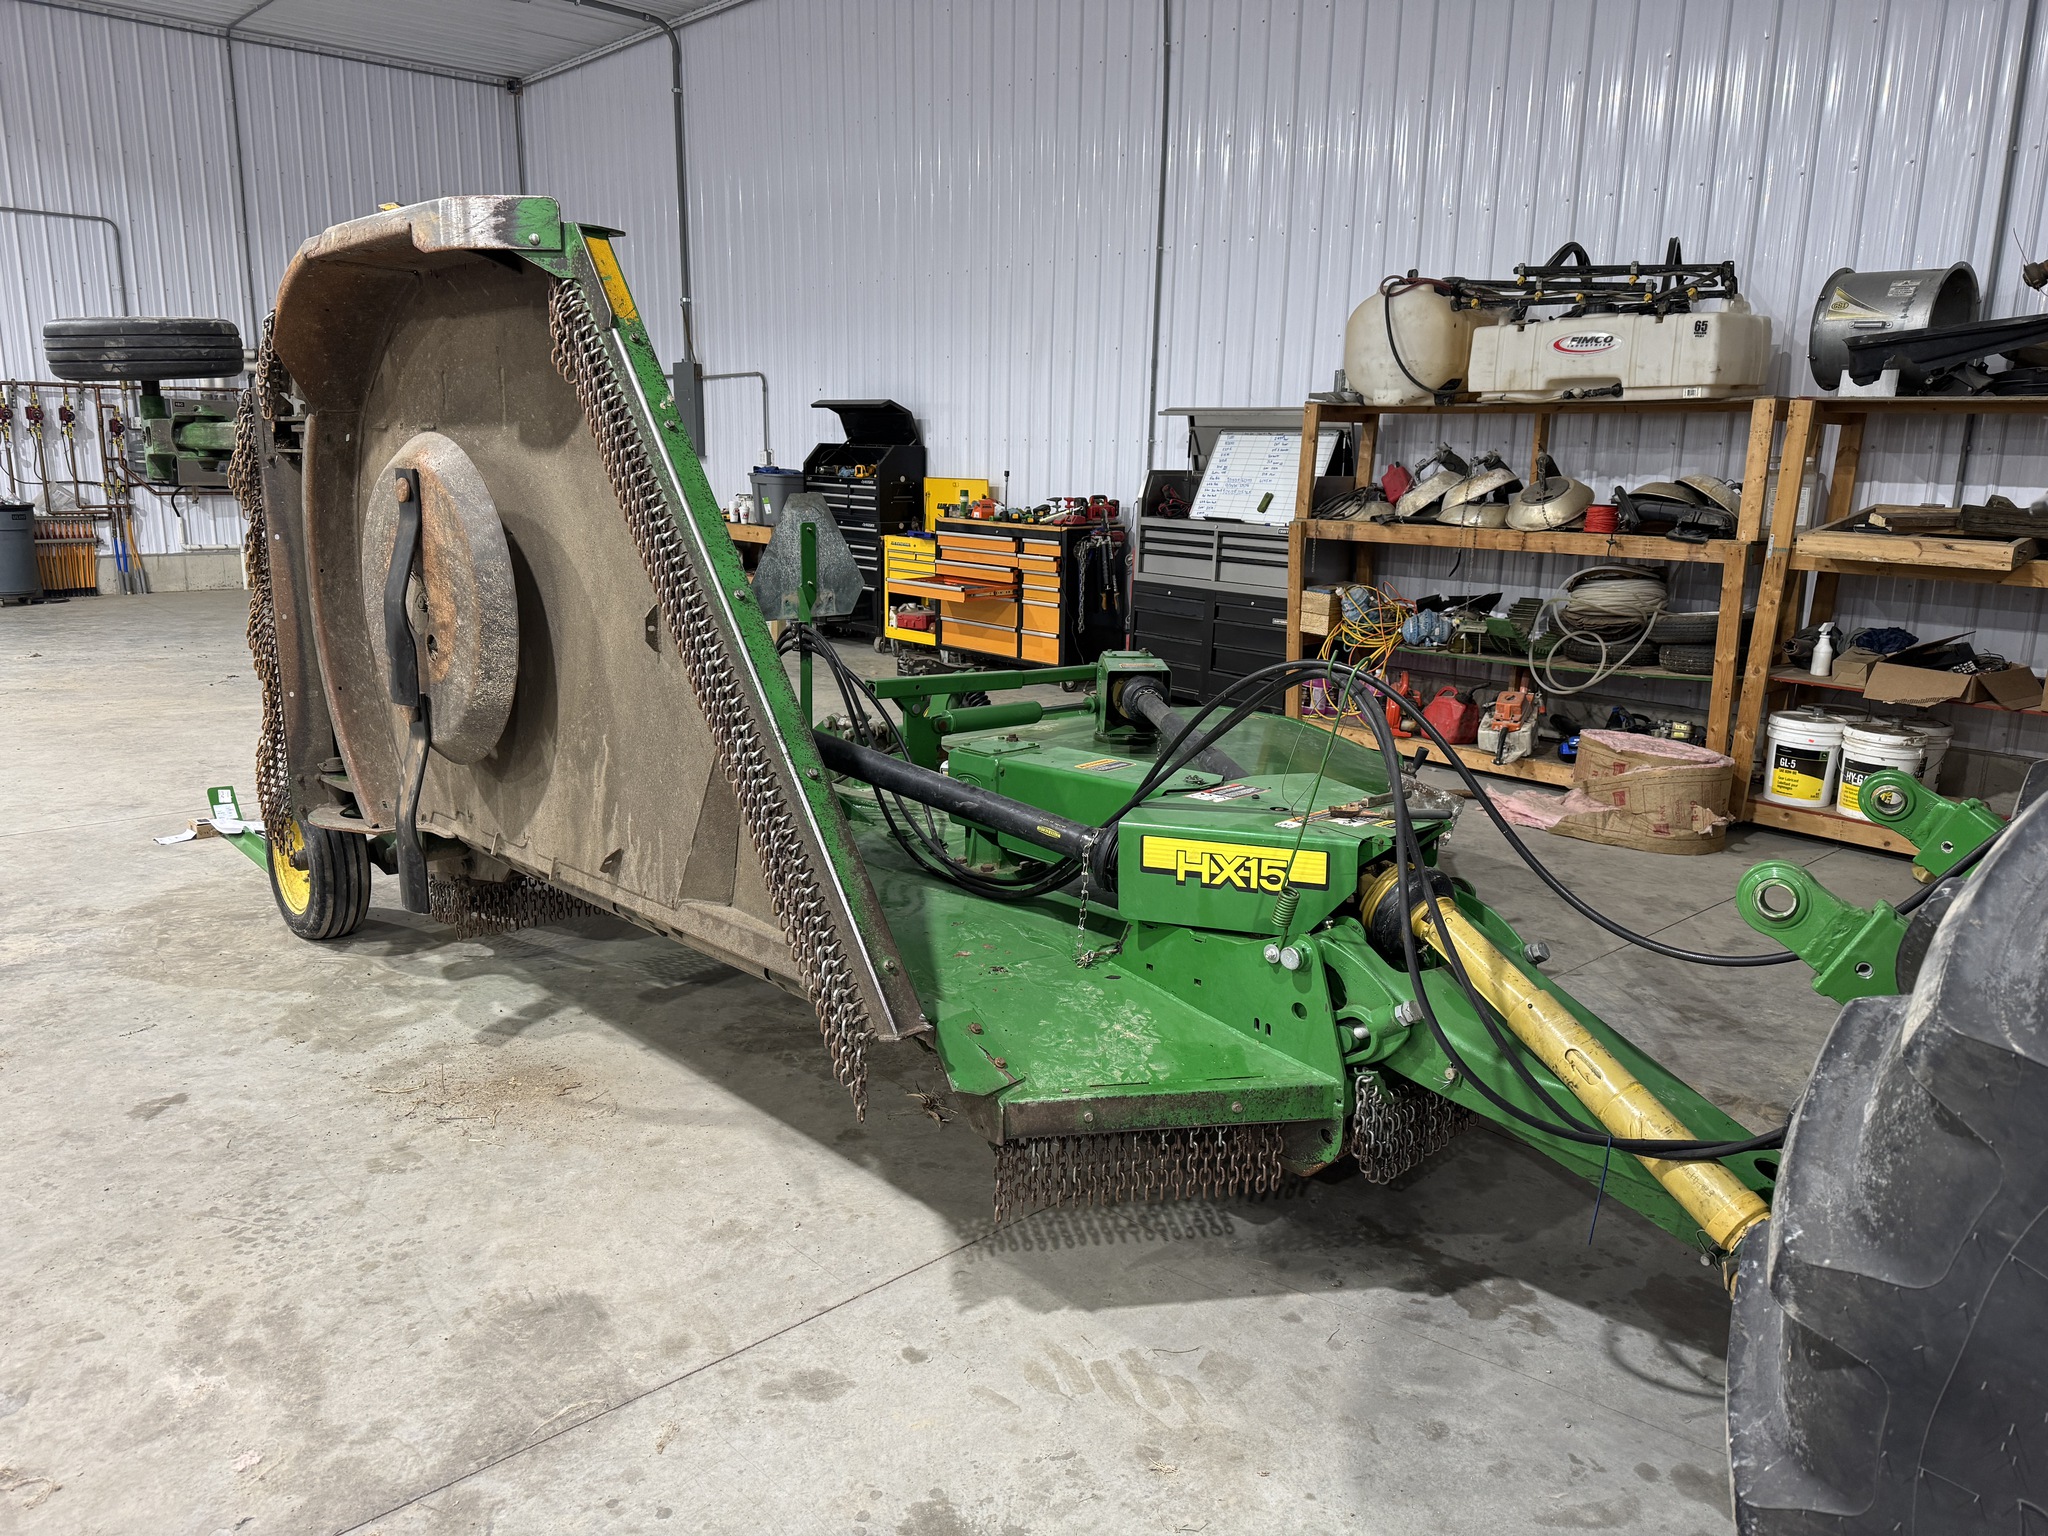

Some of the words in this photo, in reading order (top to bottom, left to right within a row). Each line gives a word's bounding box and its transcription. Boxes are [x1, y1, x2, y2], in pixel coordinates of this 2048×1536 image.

[1694, 320, 1708, 332] 65
[1570, 335, 1614, 345] FIMCO
[1780, 757, 1797, 769] GL-5
